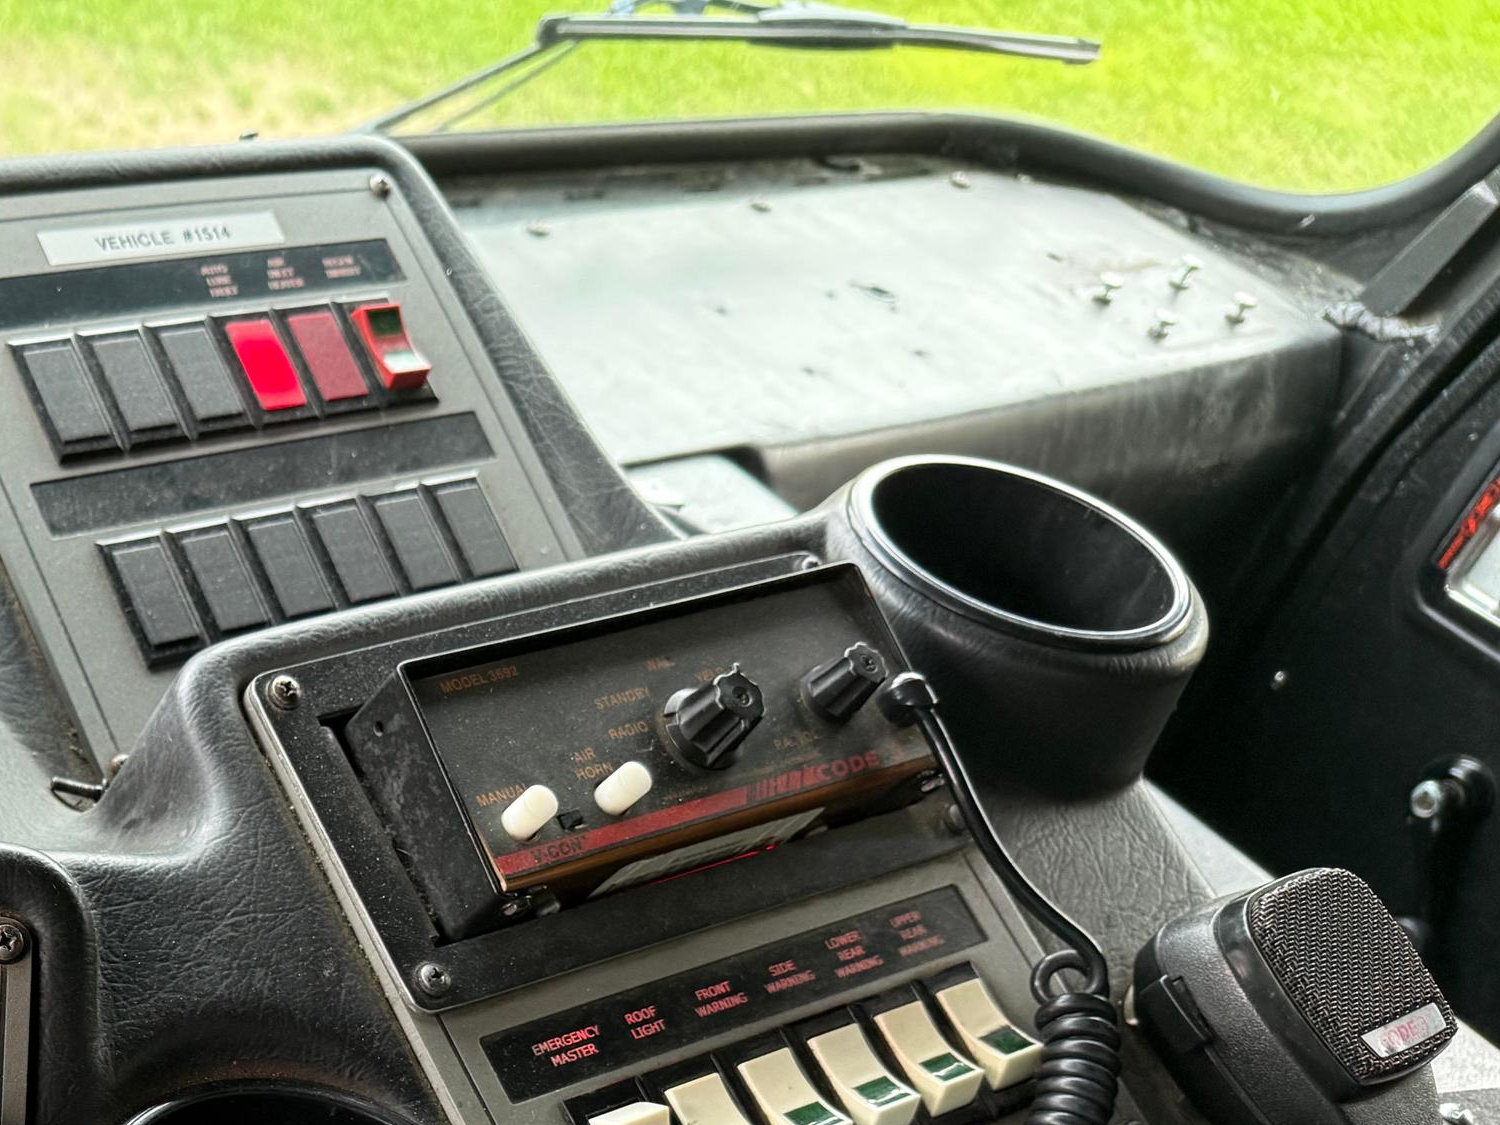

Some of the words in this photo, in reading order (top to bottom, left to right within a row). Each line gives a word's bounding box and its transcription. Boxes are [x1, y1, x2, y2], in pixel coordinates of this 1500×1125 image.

[95, 229, 175, 251] VEHICLE
[183, 226, 231, 243] #1514
[439, 672, 489, 694] MODEL
[595, 687, 650, 711] STANDBY
[608, 720, 649, 740] RADIO
[574, 746, 596, 764] AIR
[575, 762, 613, 780] HORN
[768, 959, 797, 977] SIDE
[694, 980, 730, 1001] FRONT
[764, 969, 816, 994] WARNING
[624, 1005, 657, 1024] ROOF
[694, 992, 748, 1018] WARNING
[531, 1024, 600, 1056] EMERGENCY
[630, 1019, 667, 1040] LIGHT
[550, 1043, 599, 1067] MASTER
